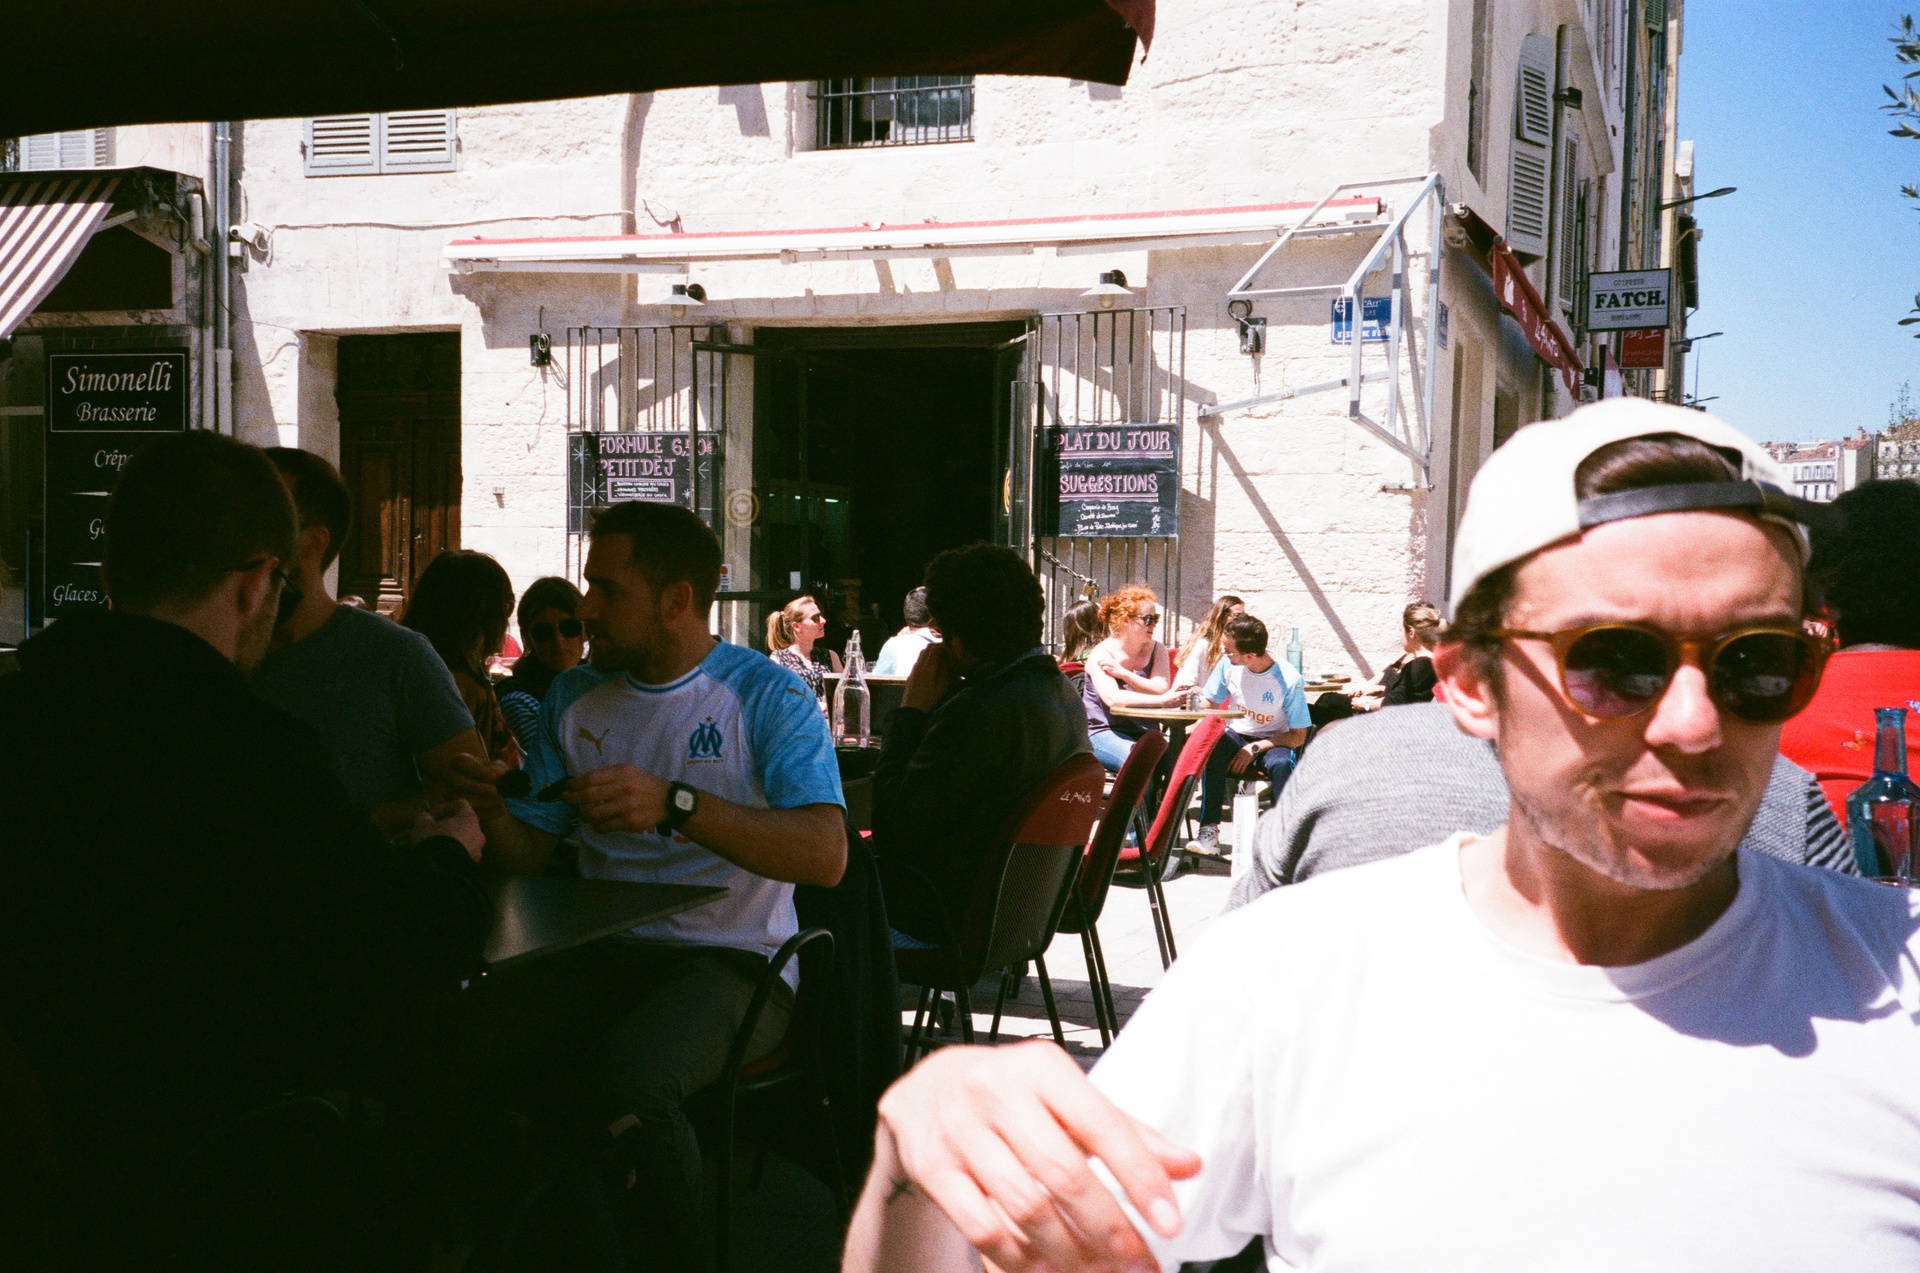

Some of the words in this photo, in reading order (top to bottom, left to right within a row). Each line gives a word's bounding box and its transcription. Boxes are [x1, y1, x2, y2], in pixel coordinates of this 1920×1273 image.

[1595, 290, 1666, 309] FATCH.
[62, 362, 172, 394] Simonelli
[76, 402, 157, 422] Brasserie
[599, 436, 663, 454] FORMULE
[1055, 431, 1094, 451] PLAT
[1096, 431, 1121, 450] DU
[1127, 431, 1170, 450] JOUR
[599, 458, 639, 476] PETIT
[1060, 473, 1158, 493] SUGGESTIONS
[53, 584, 97, 606] Glaces
